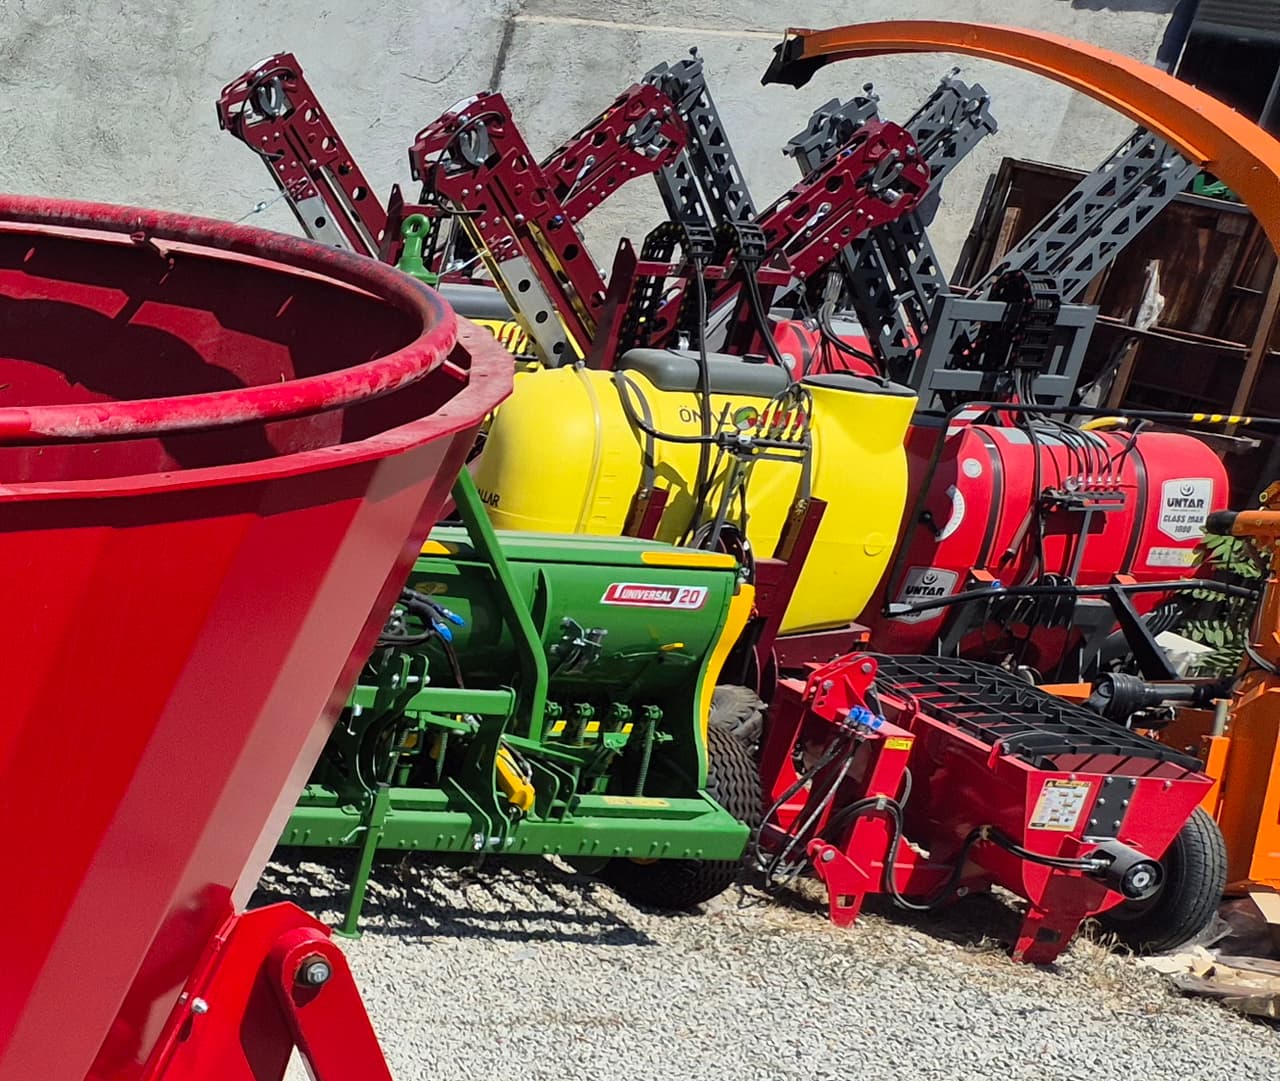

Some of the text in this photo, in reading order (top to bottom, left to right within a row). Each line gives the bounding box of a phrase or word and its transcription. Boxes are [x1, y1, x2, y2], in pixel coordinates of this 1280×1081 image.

[477, 487, 500, 508] LLAR
[1166, 497, 1205, 509] UNTAR
[621, 588, 701, 604] UNIVERSAL 20
[905, 585, 945, 597] UNTAR
